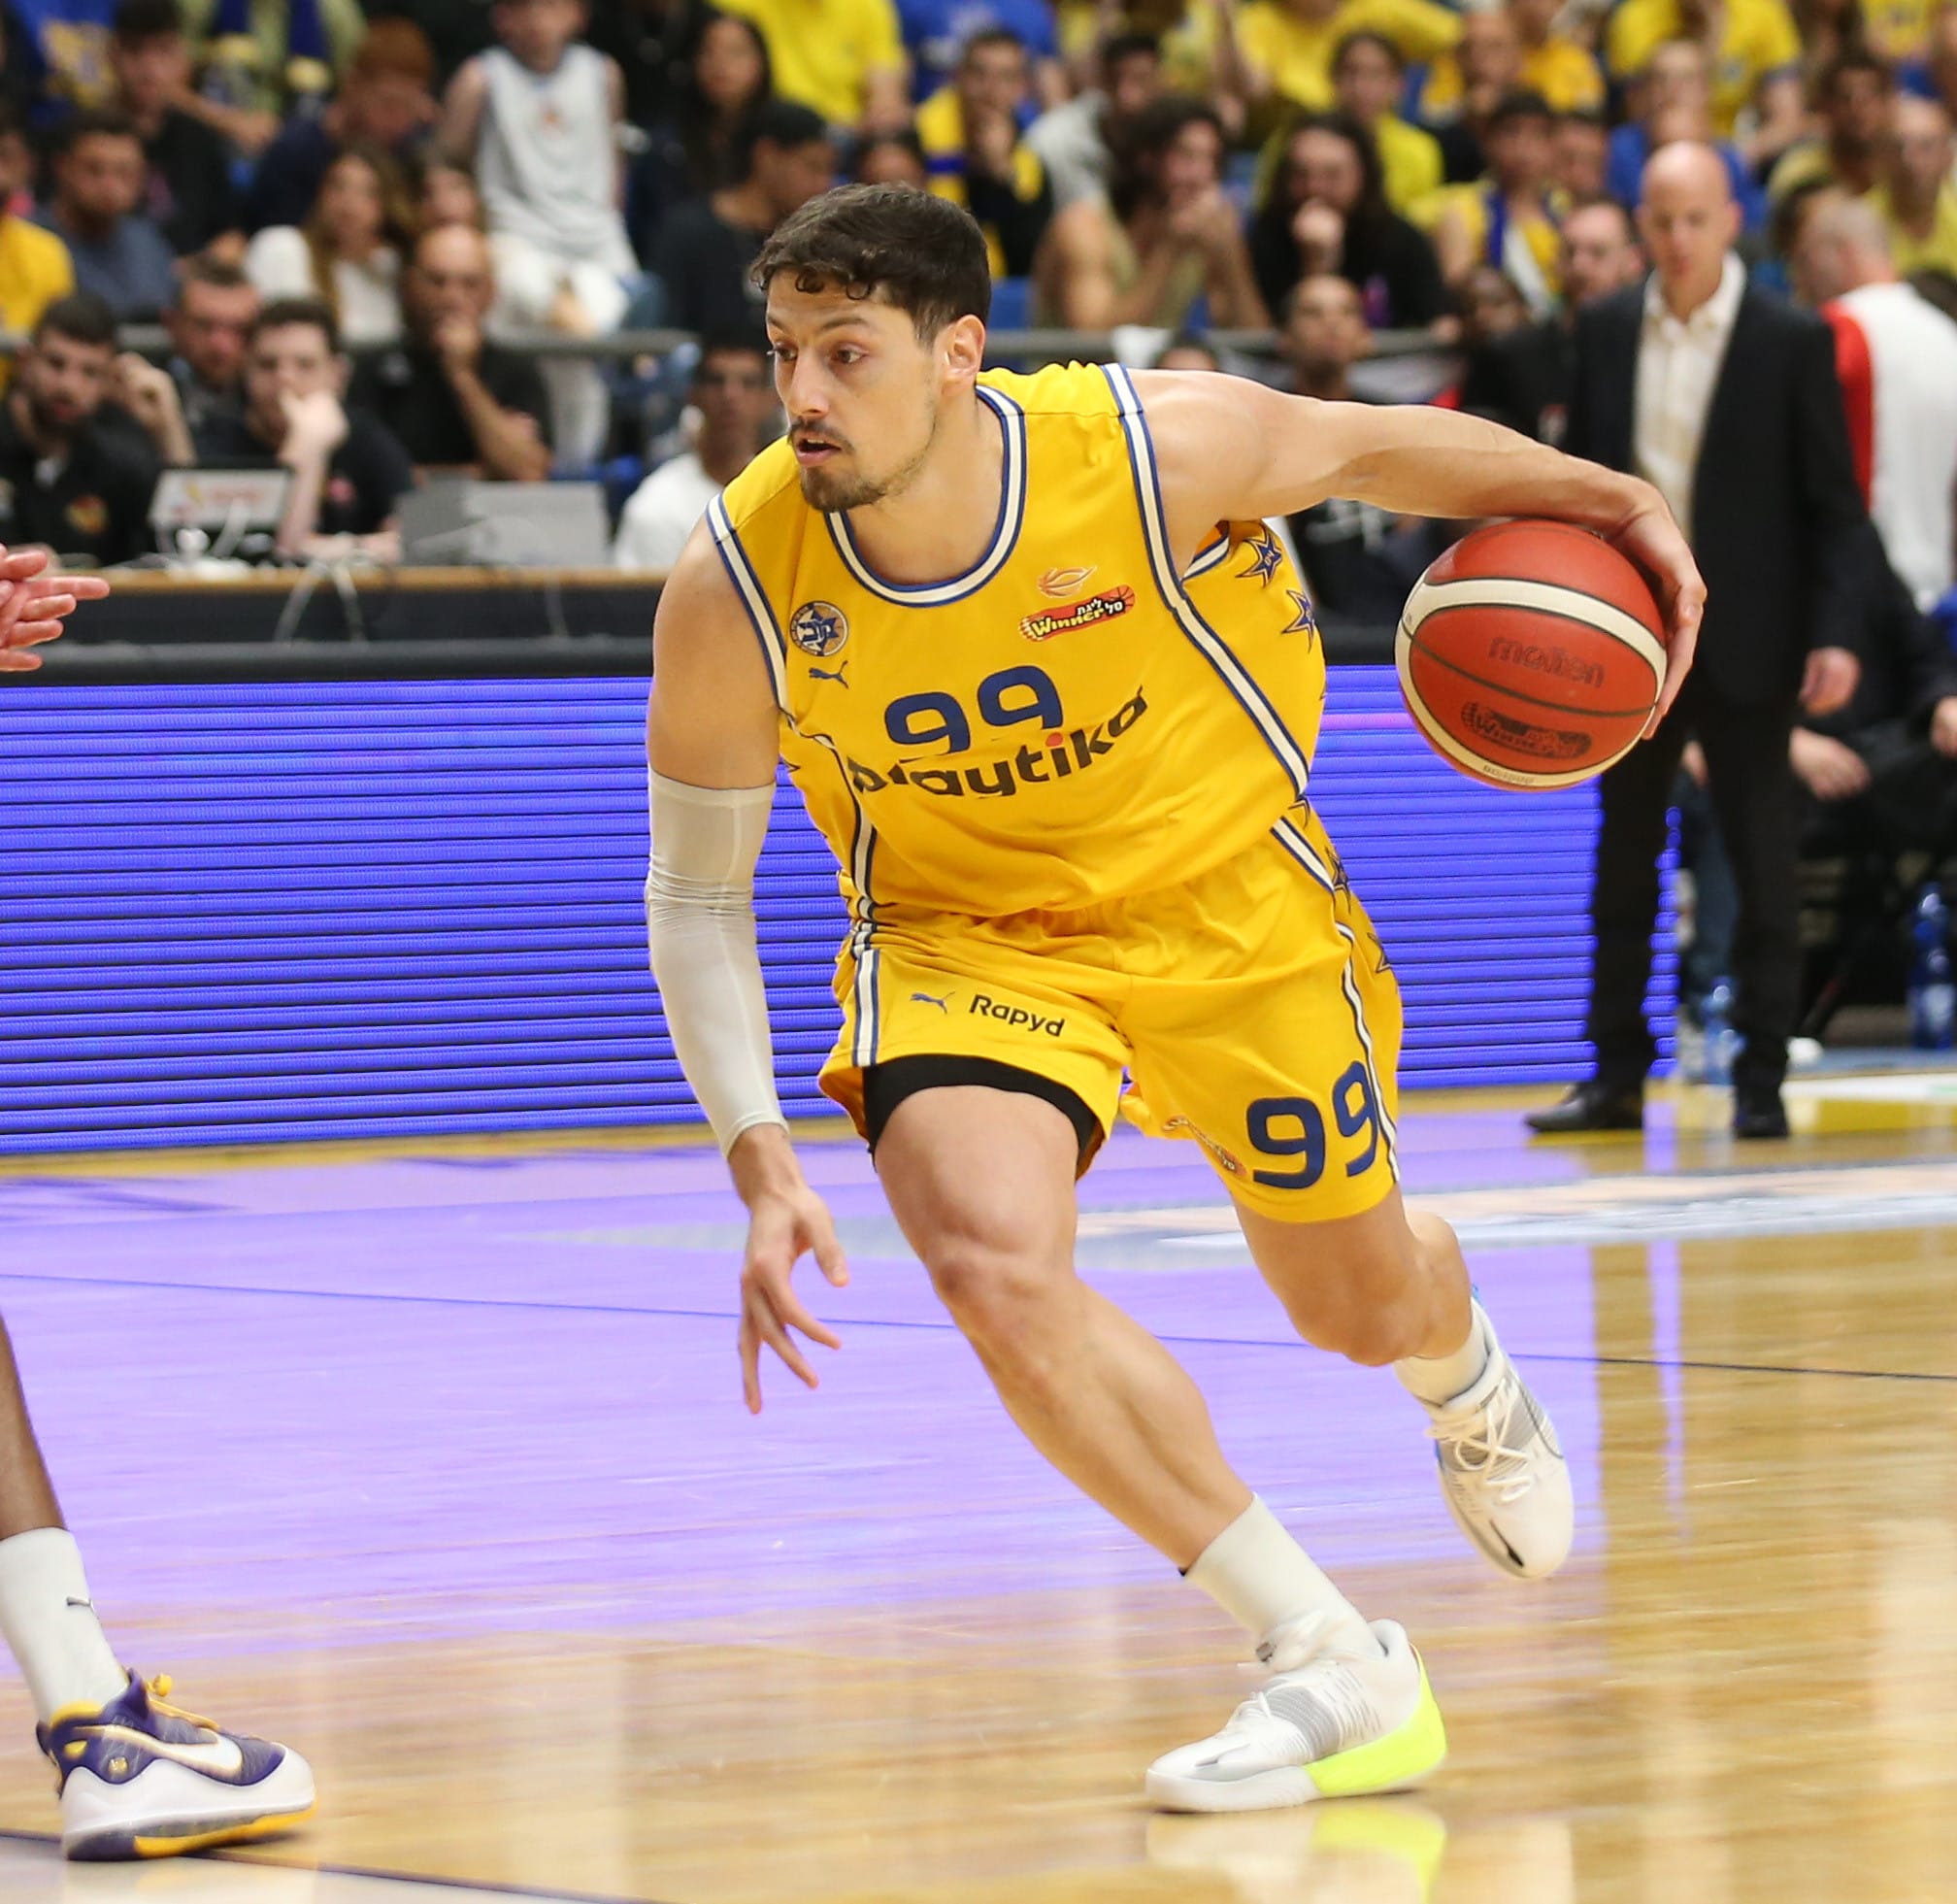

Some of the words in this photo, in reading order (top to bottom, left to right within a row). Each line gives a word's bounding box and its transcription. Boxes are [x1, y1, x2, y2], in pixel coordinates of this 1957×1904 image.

[1031, 607, 1105, 637] Winner
[1488, 636, 1605, 688] molten
[883, 664, 1064, 755] 99
[969, 993, 1065, 1038] Rapyd
[1246, 1060, 1379, 1189] 99
